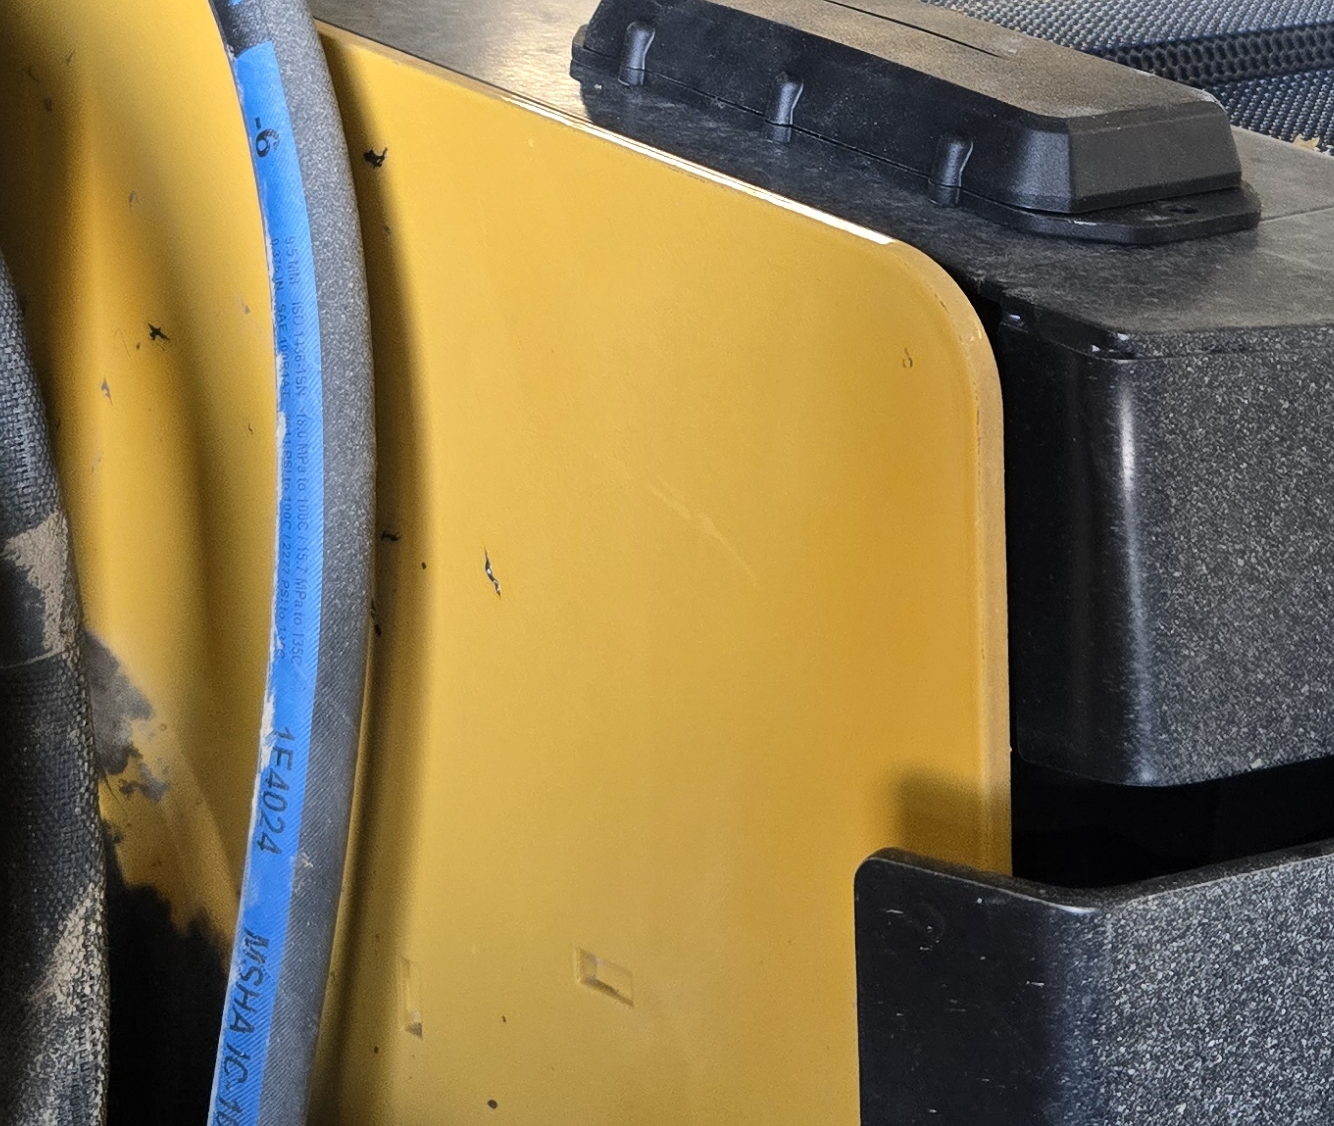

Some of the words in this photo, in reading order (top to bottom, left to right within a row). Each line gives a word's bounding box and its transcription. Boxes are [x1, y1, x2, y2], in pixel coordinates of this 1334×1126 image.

[292, 301, 304, 325] ISO
[277, 304, 287, 332] SAE
[282, 542, 292, 575] 2277
[297, 443, 309, 473] MPa
[297, 478, 307, 491] to
[295, 578, 307, 608] MPa
[293, 612, 304, 625] to
[291, 633, 305, 666] 135C
[230, 926, 270, 1034] MSHA
